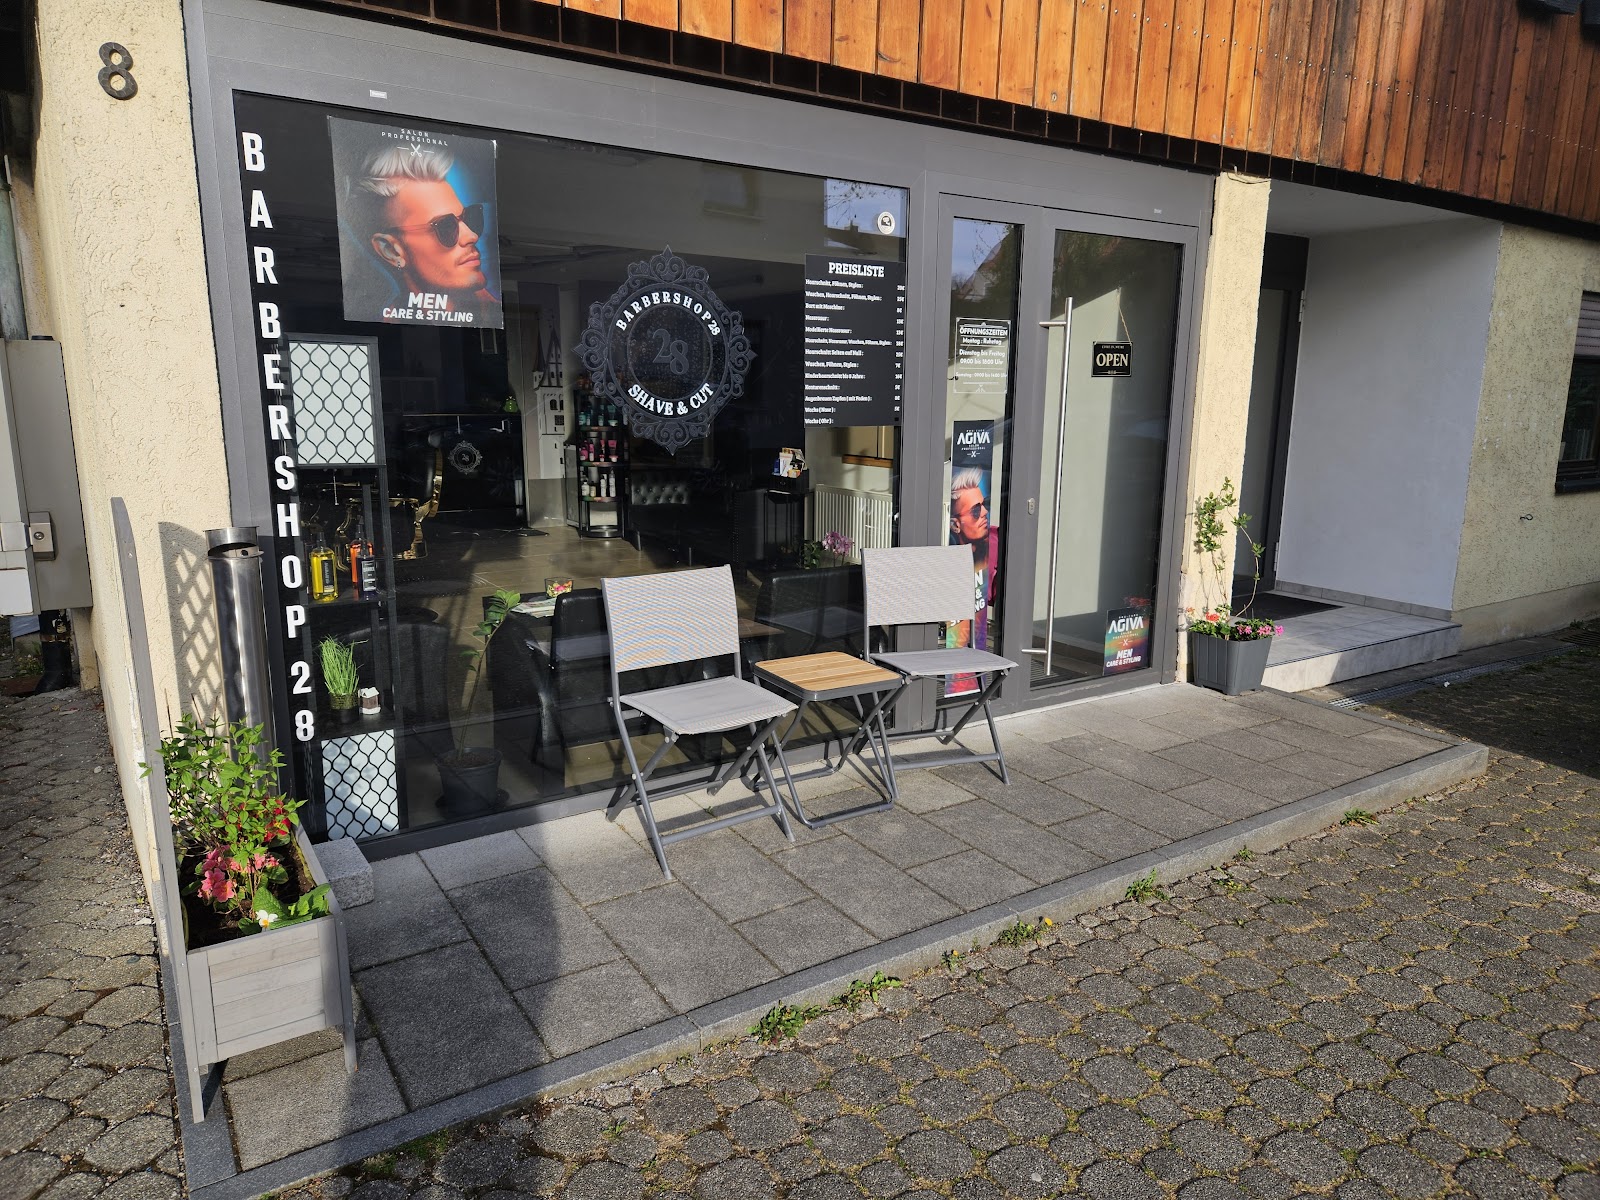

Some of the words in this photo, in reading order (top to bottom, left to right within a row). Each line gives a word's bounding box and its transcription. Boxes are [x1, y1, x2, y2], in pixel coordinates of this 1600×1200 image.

[97, 41, 138, 100] 8
[382, 132, 448, 146] PROFESSIONAL
[401, 128, 428, 137] SALON
[828, 262, 884, 278] PREISLISTE
[408, 292, 448, 310] MEN
[382, 308, 414, 319] CARE
[416, 310, 424, 320] &
[426, 310, 474, 322] STYLING
[960, 326, 1008, 336] ÖFFNUNGSZEITEN
[652, 328, 689, 375] 28
[1096, 353, 1128, 366] OPEN
[628, 384, 674, 416] SHAVE
[677, 401, 688, 415] &
[690, 382, 714, 409] CUT
[957, 432, 990, 445] AGIVA
[1108, 616, 1144, 633] AGIVA
[1116, 648, 1133, 659] MEN
[1123, 656, 1142, 665] STYLING
